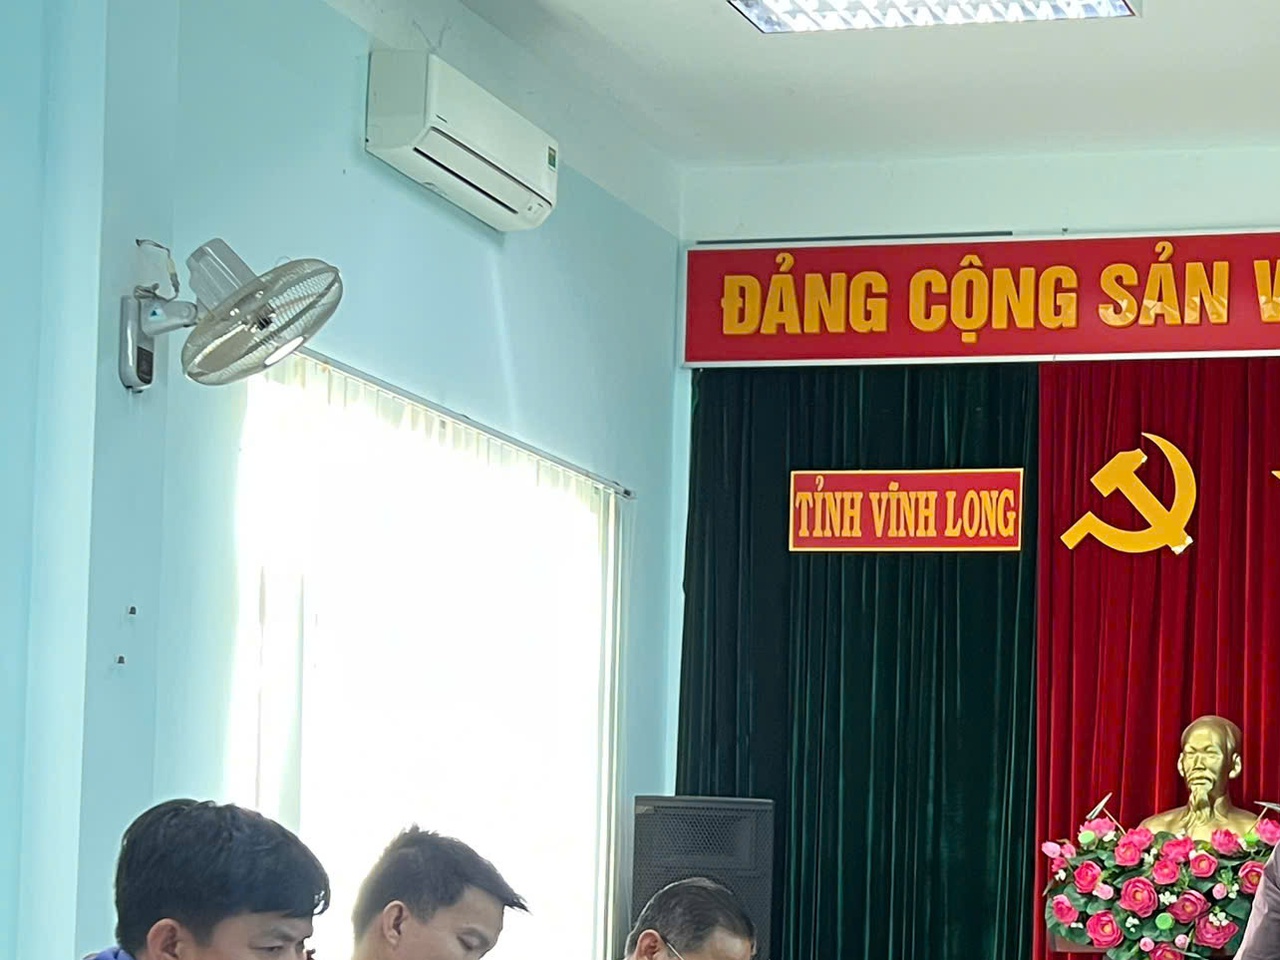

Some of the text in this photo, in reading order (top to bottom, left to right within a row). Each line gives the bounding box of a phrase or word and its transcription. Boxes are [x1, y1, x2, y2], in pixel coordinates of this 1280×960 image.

[721, 252, 887, 335] ĐẢNG
[909, 254, 1077, 343] CỘNG
[1097, 241, 1229, 328] SẢN
[795, 475, 1016, 538] TỈNH VĨNH LONG
